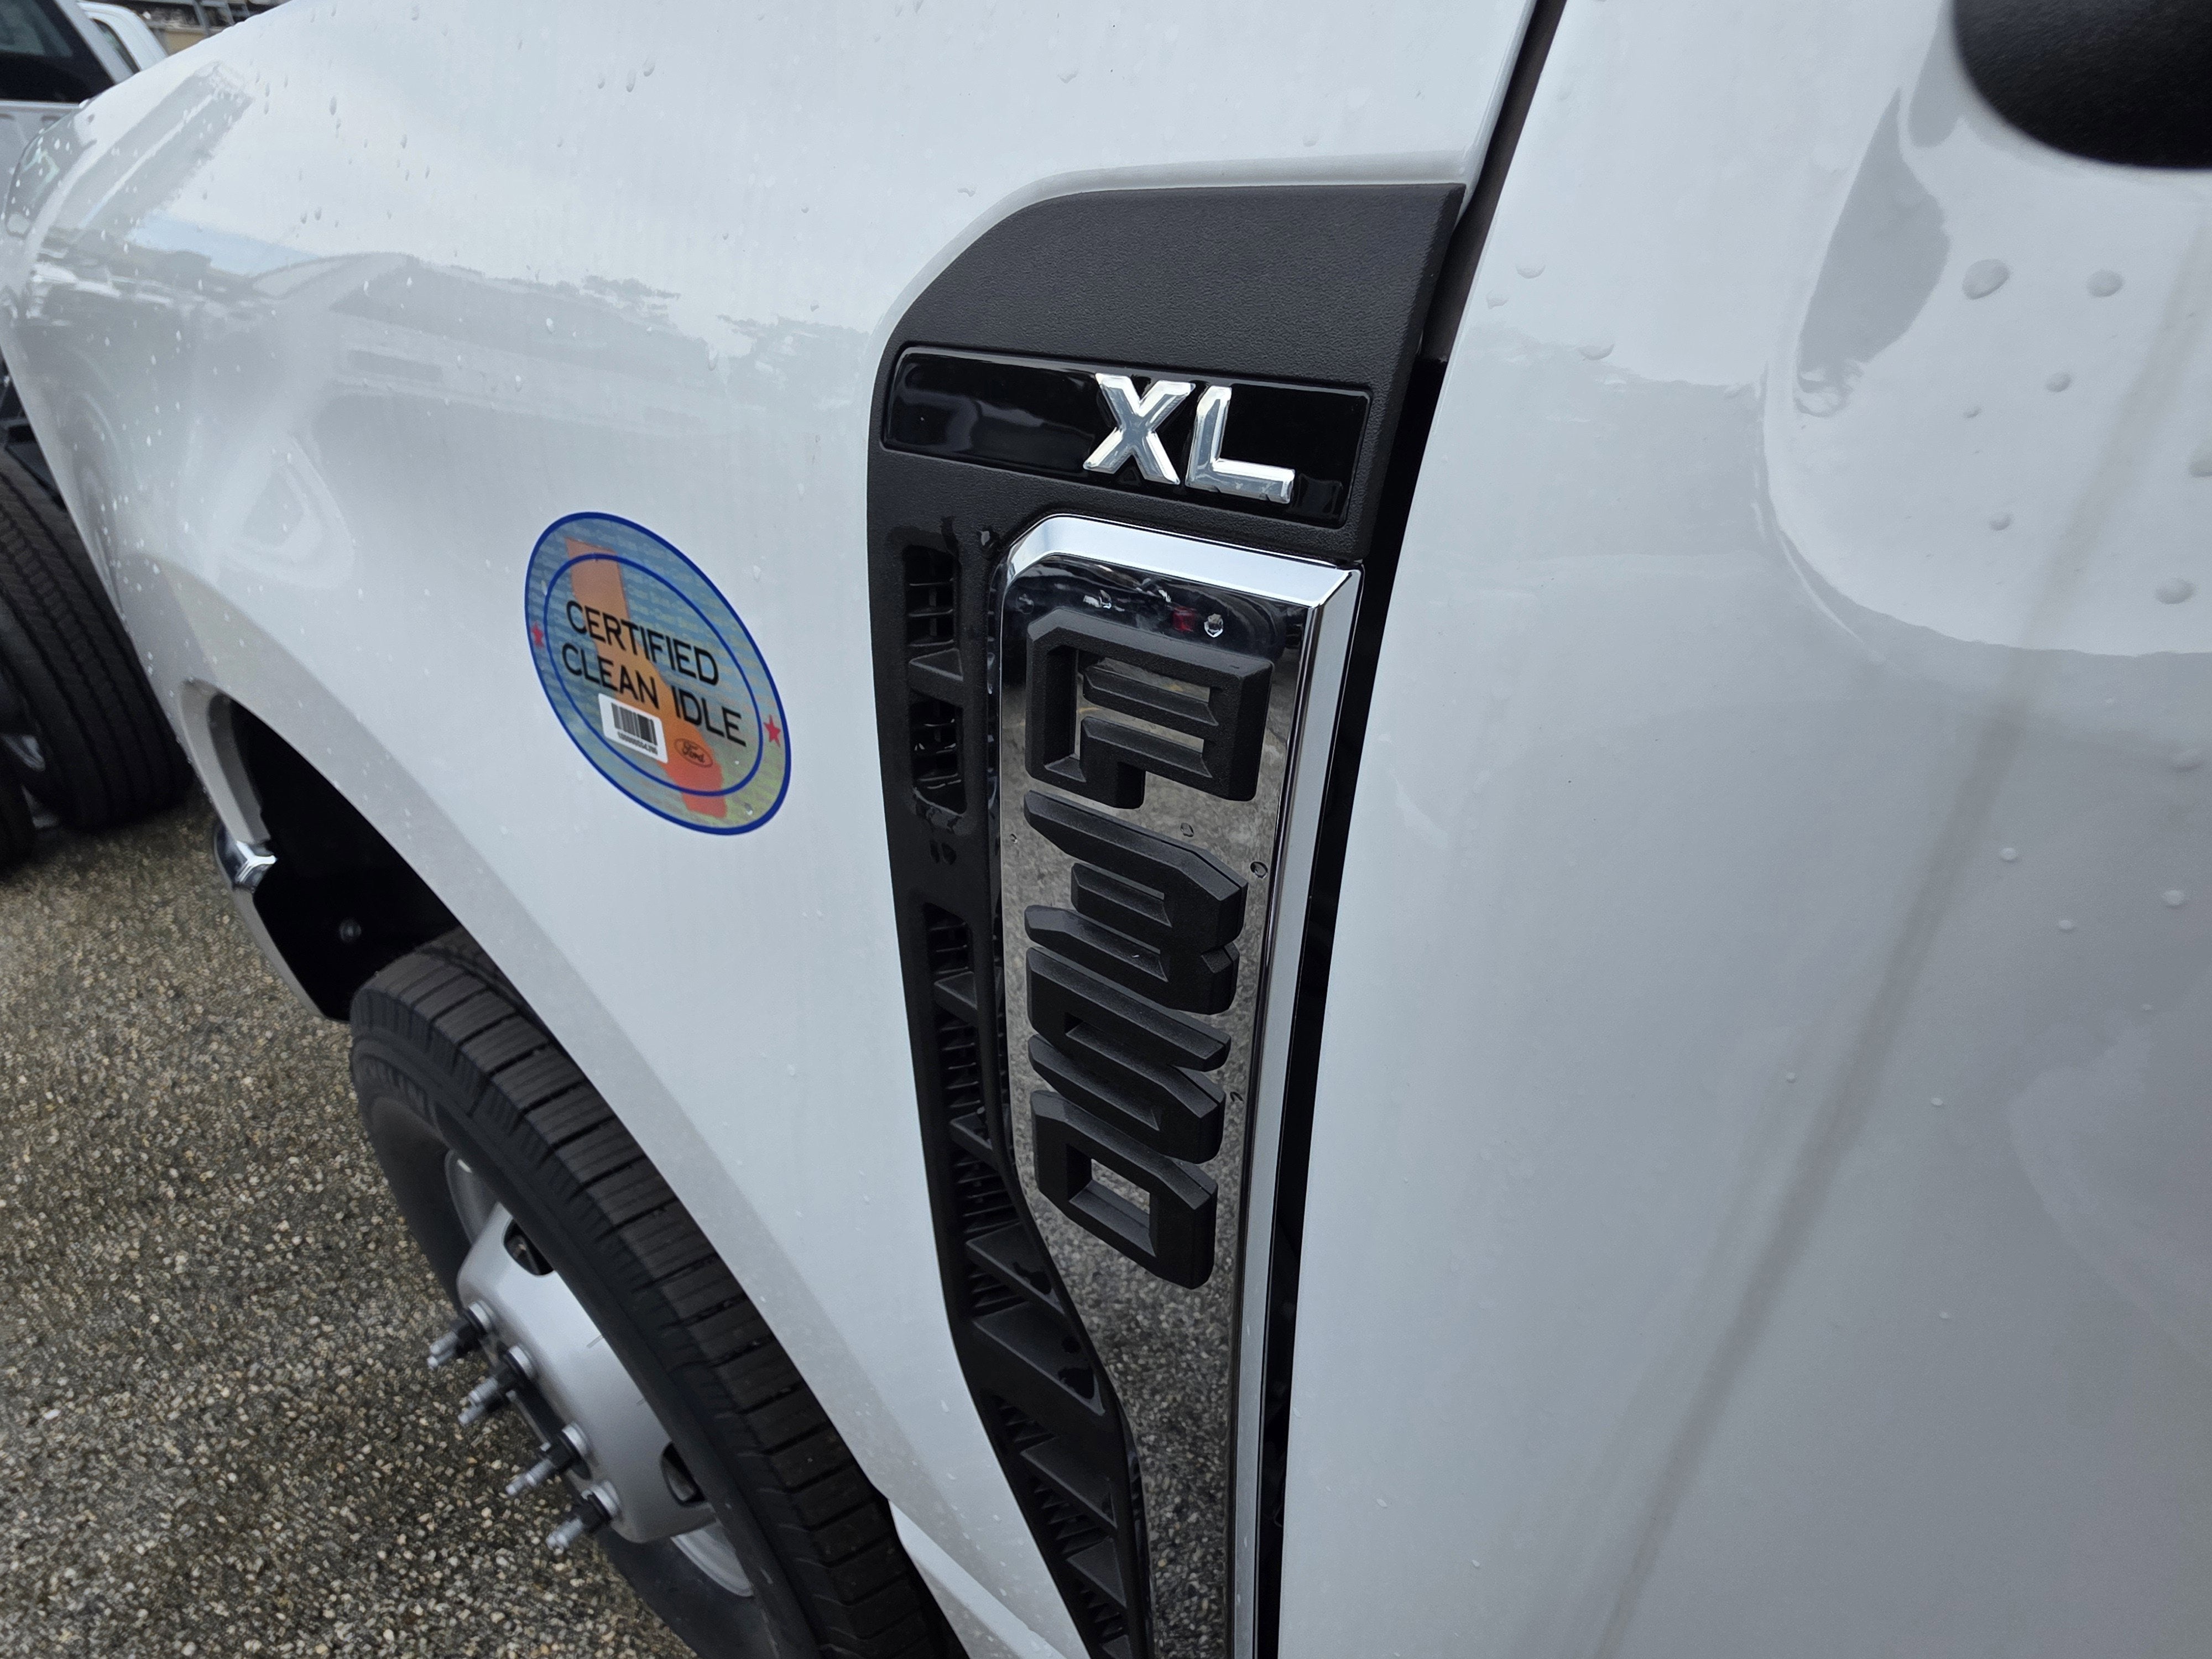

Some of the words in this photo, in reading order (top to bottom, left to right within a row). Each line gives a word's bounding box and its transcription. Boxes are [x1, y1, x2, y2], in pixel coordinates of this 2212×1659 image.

[1083, 373, 1295, 504] XL
[566, 601, 719, 686] CERTIFIED
[562, 644, 659, 709] CLEAN
[672, 687, 747, 747] IDLE
